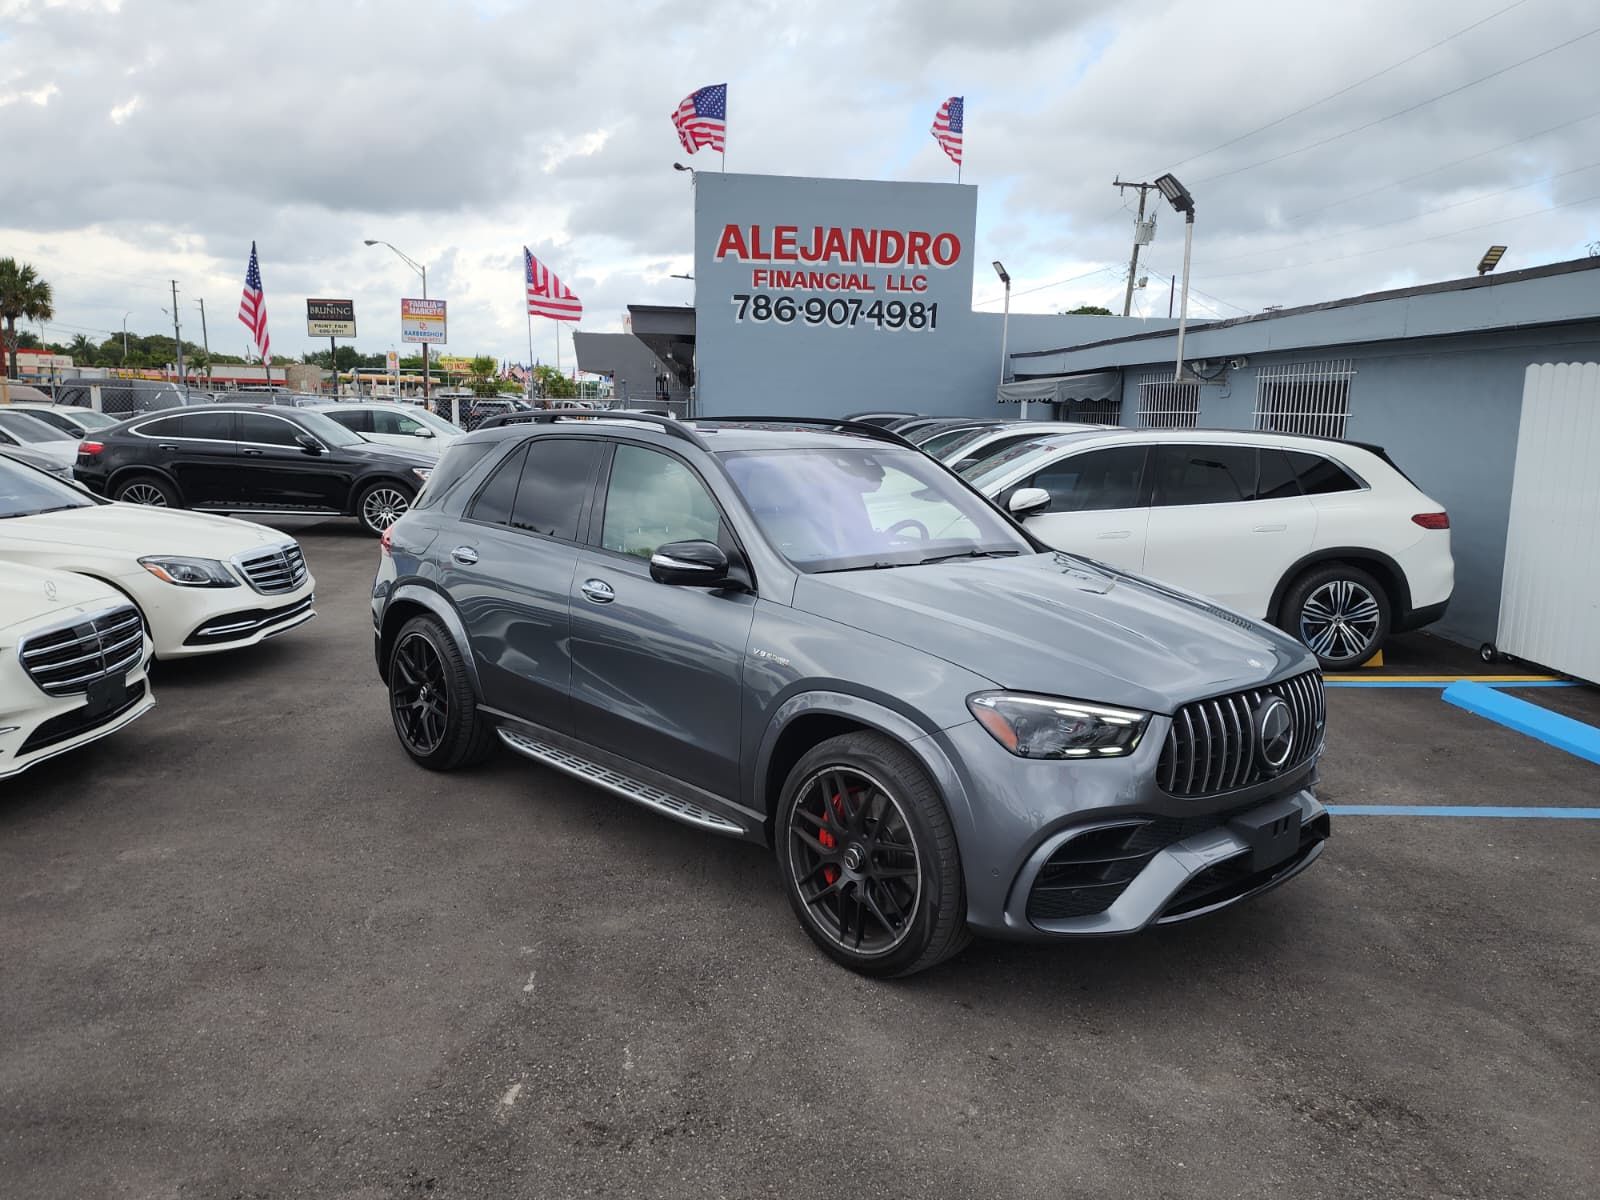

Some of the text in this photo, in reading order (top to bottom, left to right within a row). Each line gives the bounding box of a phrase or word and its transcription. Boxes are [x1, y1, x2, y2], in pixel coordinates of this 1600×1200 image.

[714, 223, 961, 268] ALEJANDRO
[752, 269, 928, 292] FINANCIAL LLC
[310, 306, 351, 315] BRUNING
[408, 301, 437, 309] FAMILIA
